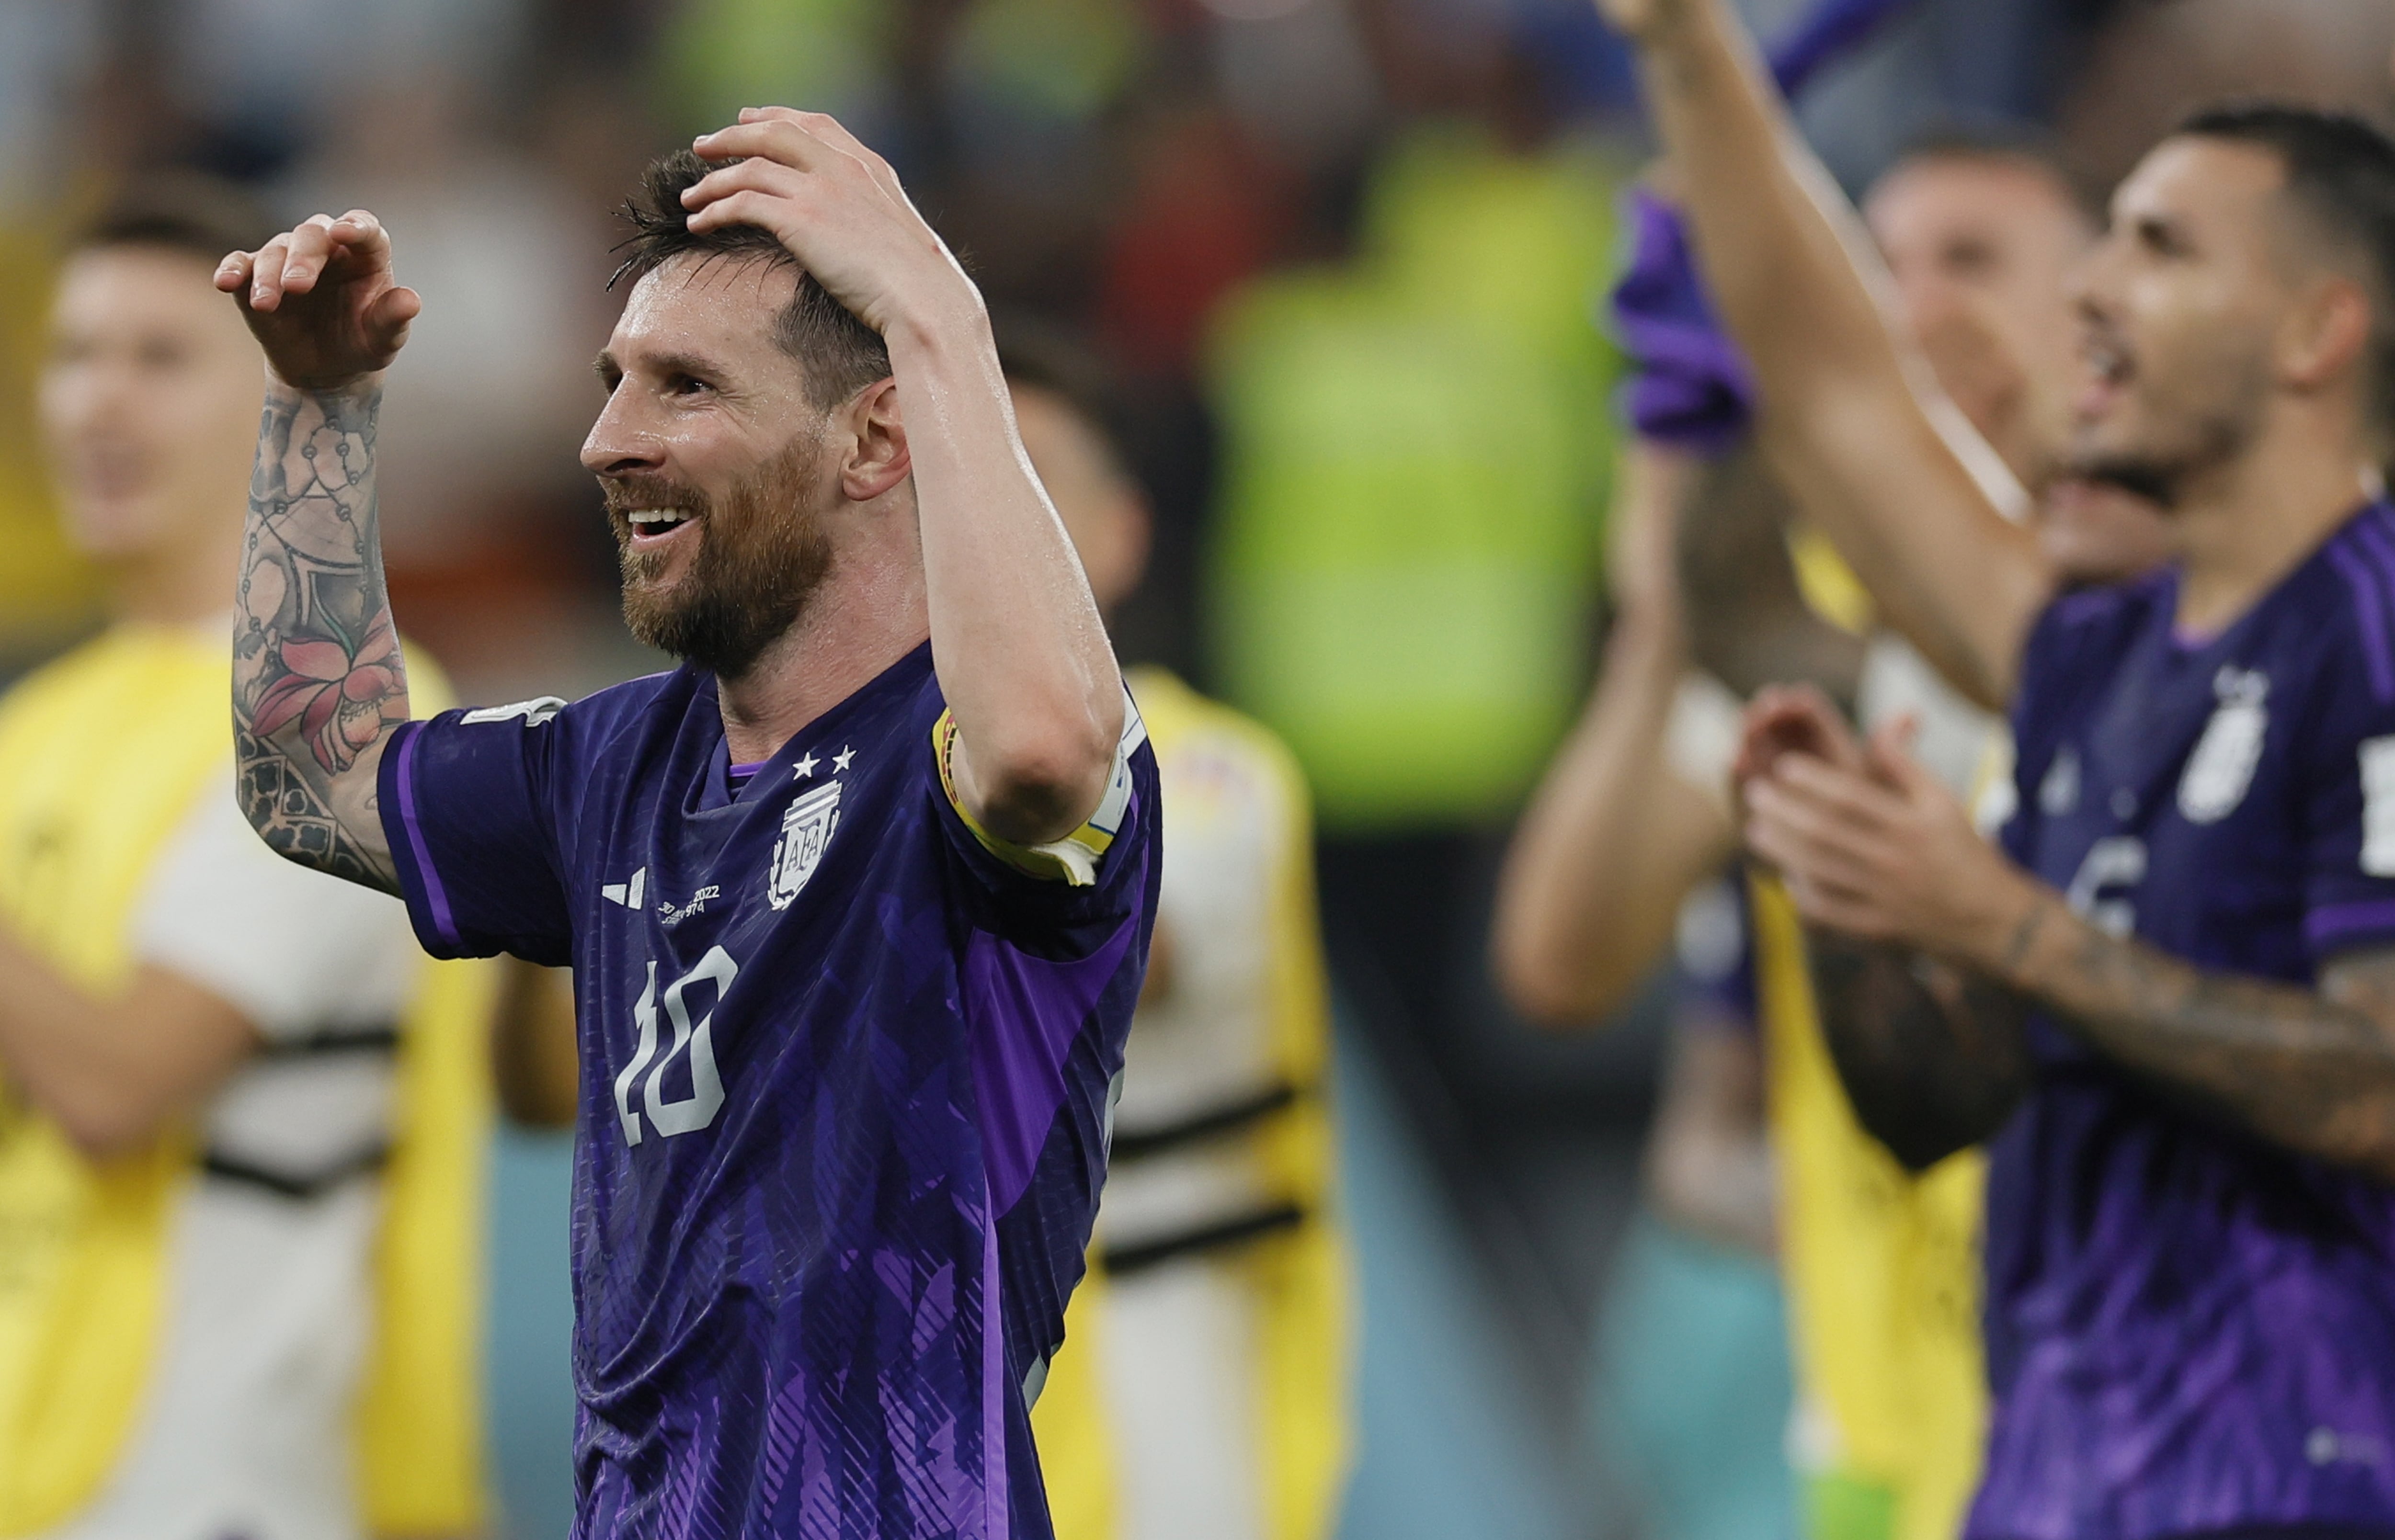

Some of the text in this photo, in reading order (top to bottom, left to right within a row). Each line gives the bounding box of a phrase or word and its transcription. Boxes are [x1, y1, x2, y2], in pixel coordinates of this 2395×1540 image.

[785, 817, 821, 873] AFA
[658, 901, 675, 914] 30
[693, 885, 720, 903] 2022
[685, 901, 705, 917] 974
[614, 944, 739, 1147] 10
